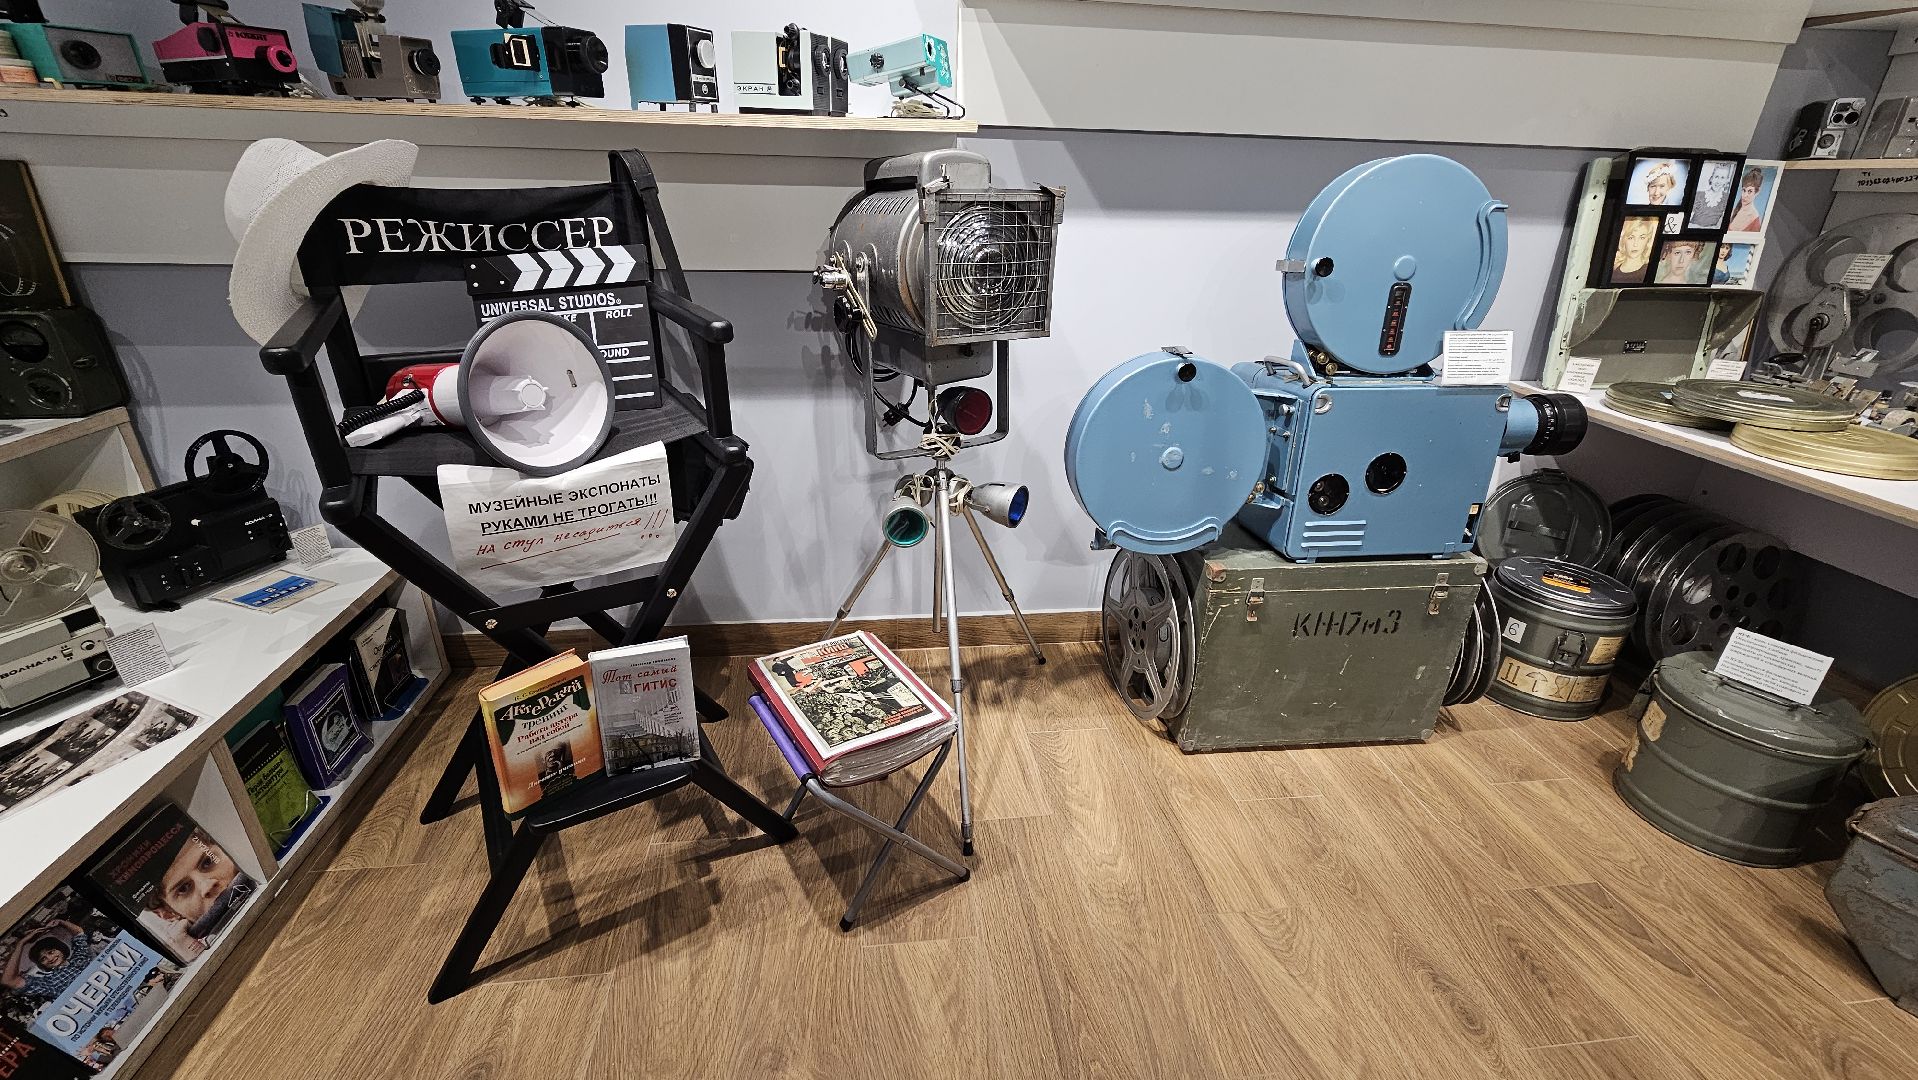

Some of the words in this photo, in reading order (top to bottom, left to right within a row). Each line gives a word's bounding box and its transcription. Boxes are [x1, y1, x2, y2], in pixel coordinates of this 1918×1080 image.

[337, 216, 614, 254] РЕЖИССЕР
[480, 298, 555, 317] UNIVERSAL
[605, 309, 633, 319] ROLL
[468, 492, 564, 515] МУЗЕЙНЫЕ
[568, 474, 661, 502] ЭКСПОНАТЫ
[480, 514, 549, 534] РУКАМИ
[553, 510, 574, 524] НЕ
[578, 493, 658, 518] ТРОГАТЬ!!!
[503, 537, 544, 553] стул
[1509, 623, 1520, 635] 6
[0, 655, 58, 679] ВОЛНА-М
[602, 669, 632, 685] Тот
[637, 665, 677, 678] самый
[633, 678, 677, 693] ГИТИС
[517, 726, 549, 743] Работа
[550, 712, 579, 729] актера
[521, 702, 568, 730] тренинг
[528, 734, 546, 745] над
[546, 722, 571, 737] собой
[46, 942, 143, 1037] ОЧЕРКИ
